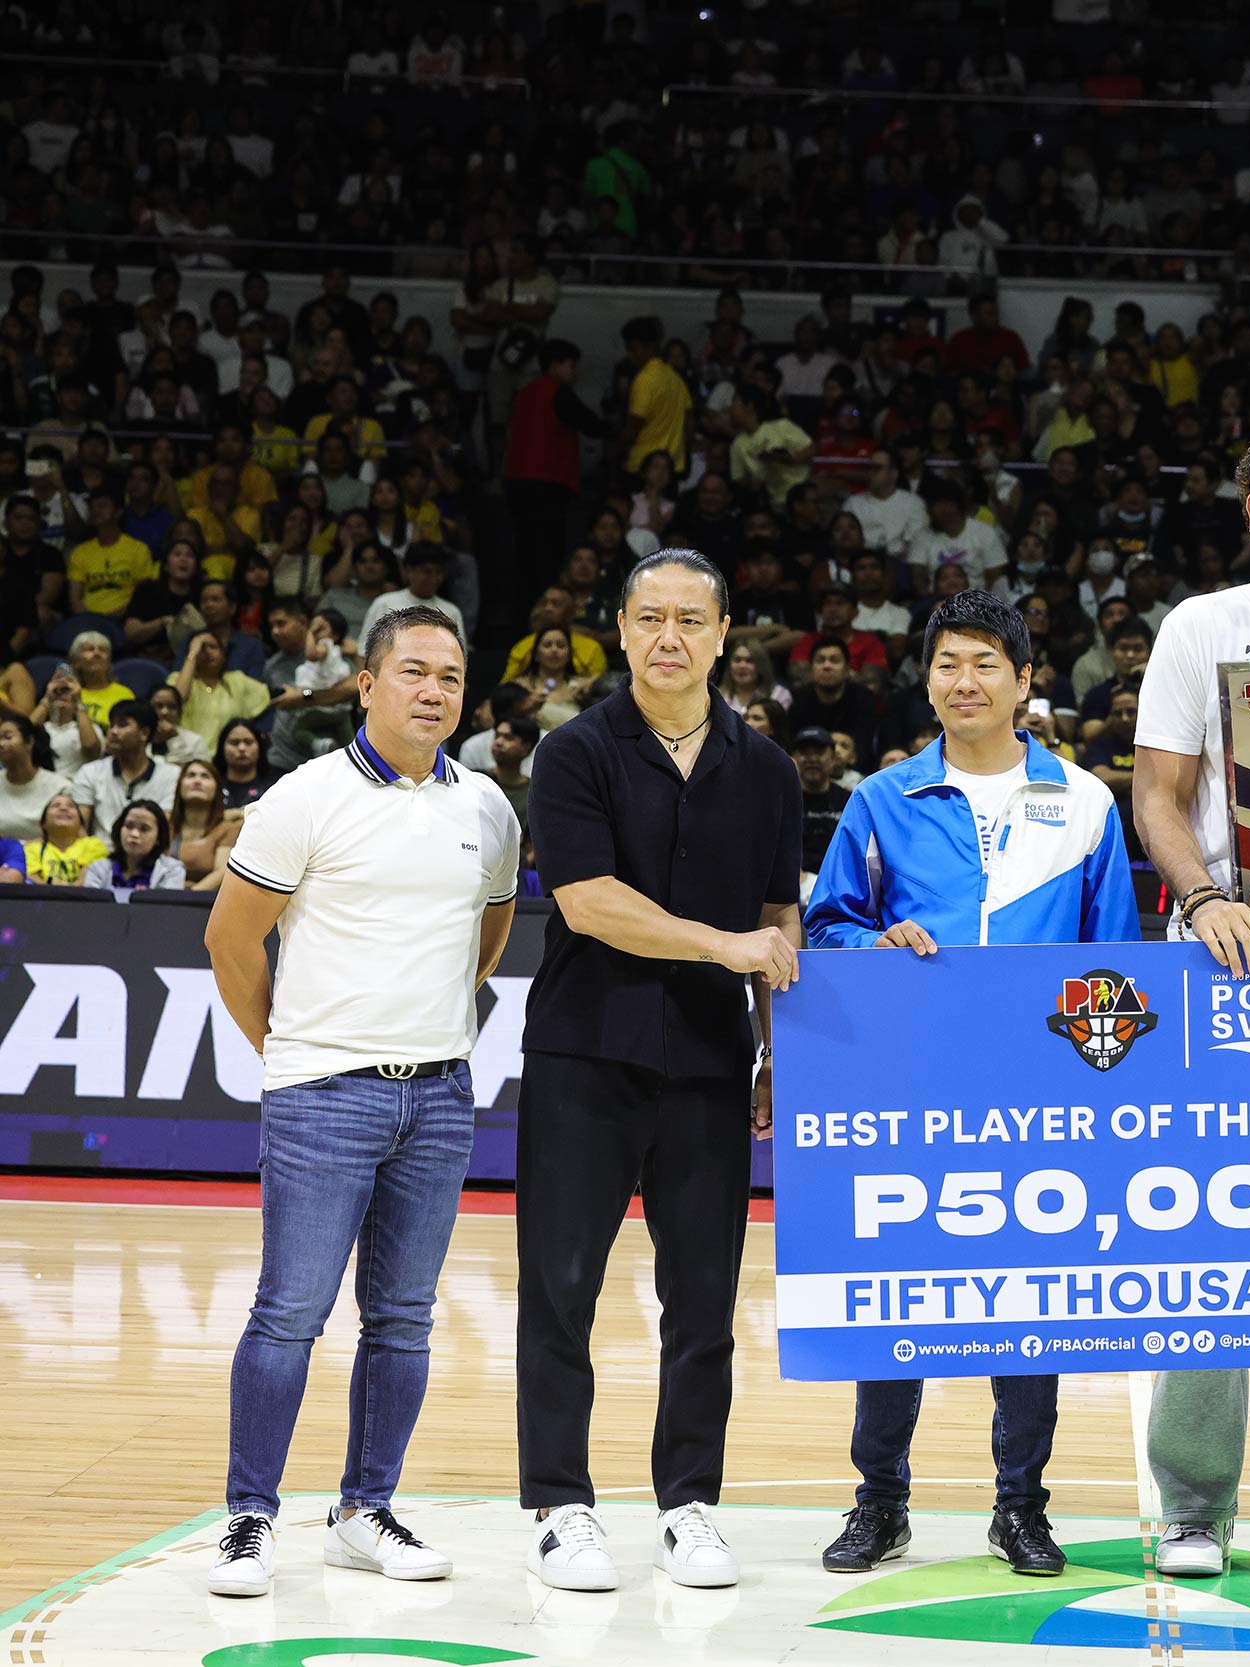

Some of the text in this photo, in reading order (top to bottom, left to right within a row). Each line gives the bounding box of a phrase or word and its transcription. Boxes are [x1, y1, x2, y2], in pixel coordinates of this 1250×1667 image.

[1024, 803, 1064, 812] POCARI
[1024, 810, 1061, 818] SWEAT
[461, 842, 478, 852] BOSS
[1211, 974, 1229, 982] ION
[1062, 977, 1146, 1017] PBA
[1081, 1045, 1124, 1058] SEASON
[1096, 1056, 1110, 1069] 49
[796, 1111, 908, 1148] BEST
[924, 1106, 1096, 1144] PLAYER
[1110, 1104, 1173, 1140] OF
[846, 1275, 1008, 1322] FIFTY
[918, 1340, 1014, 1357] www.pba.ph
[1045, 1336, 1136, 1353] /PBAOfficial
